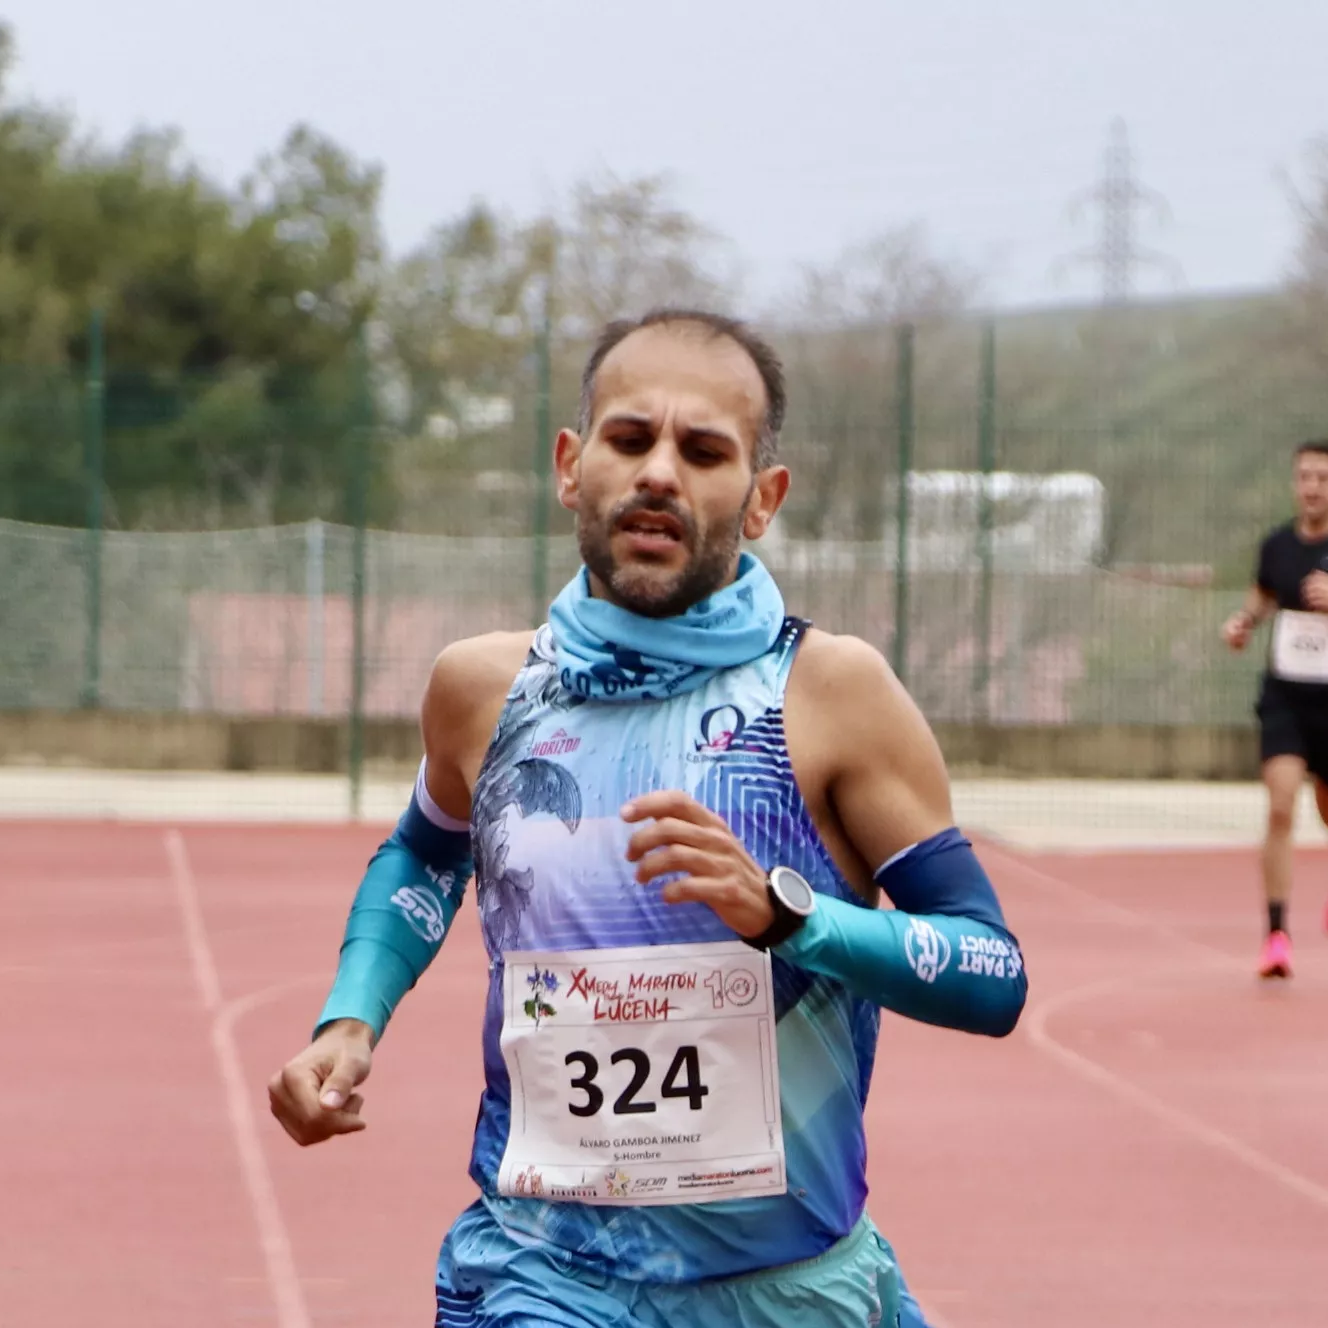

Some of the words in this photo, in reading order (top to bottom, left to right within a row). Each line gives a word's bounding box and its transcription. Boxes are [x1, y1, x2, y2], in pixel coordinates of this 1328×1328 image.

[594, 997, 682, 1021] LUCENA
[564, 1045, 709, 1117] 324
[579, 1137, 611, 1149] ÁLVARO
[613, 1136, 658, 1148] GAMBOA
[660, 1133, 702, 1145] JIMÉNEZ
